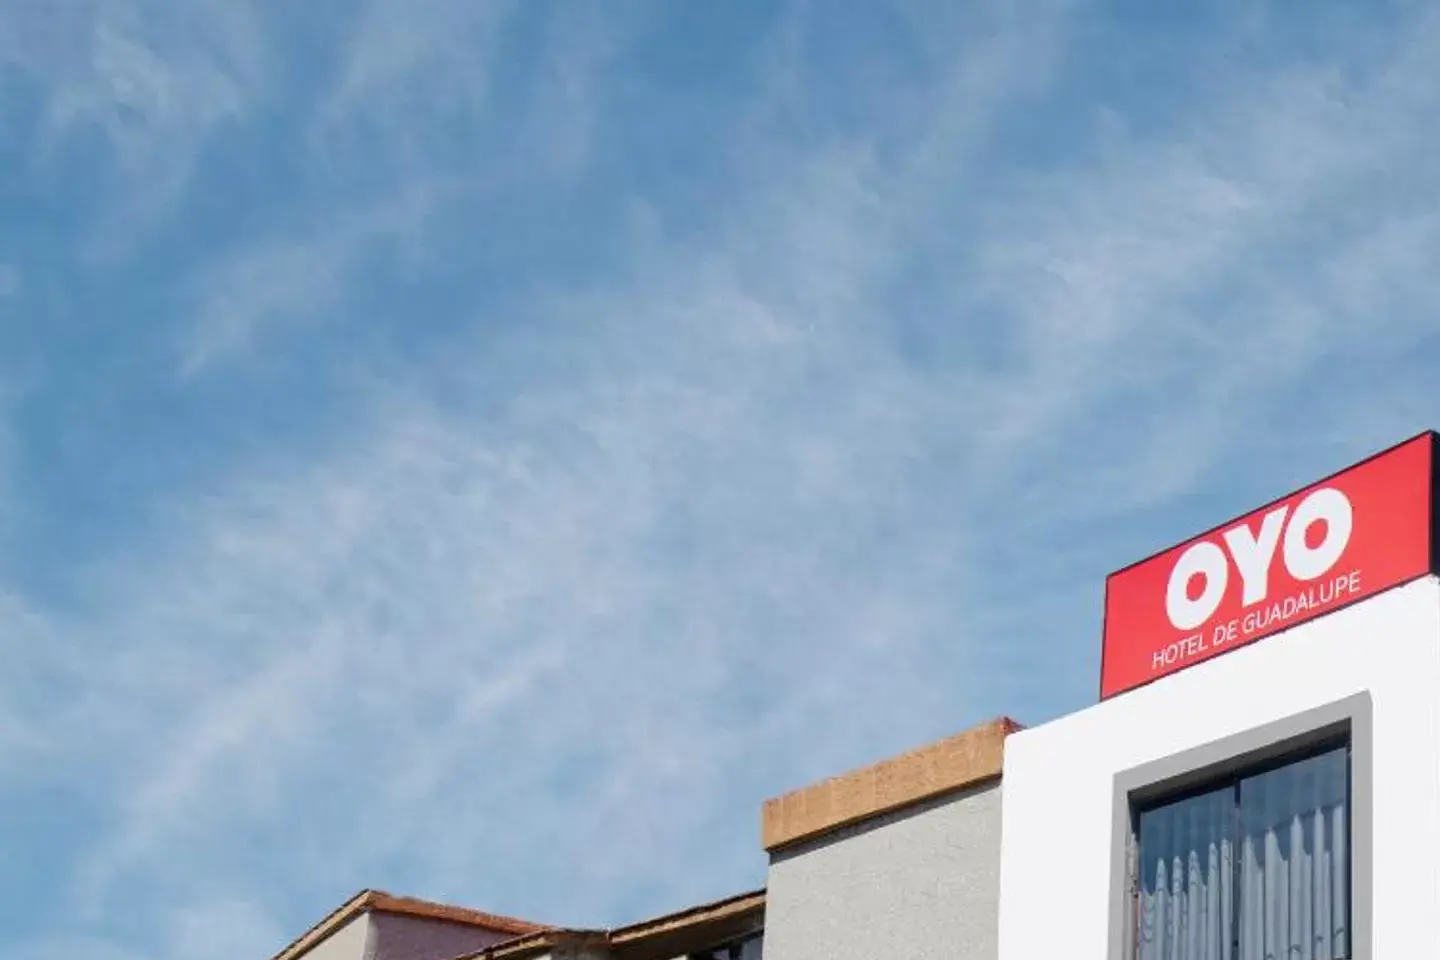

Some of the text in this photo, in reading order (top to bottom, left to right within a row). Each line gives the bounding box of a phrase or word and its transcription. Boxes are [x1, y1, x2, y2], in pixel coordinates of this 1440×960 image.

[1152, 569, 1361, 669] HOTEL DE GUADALUPE
[1165, 487, 1353, 631] OYO
